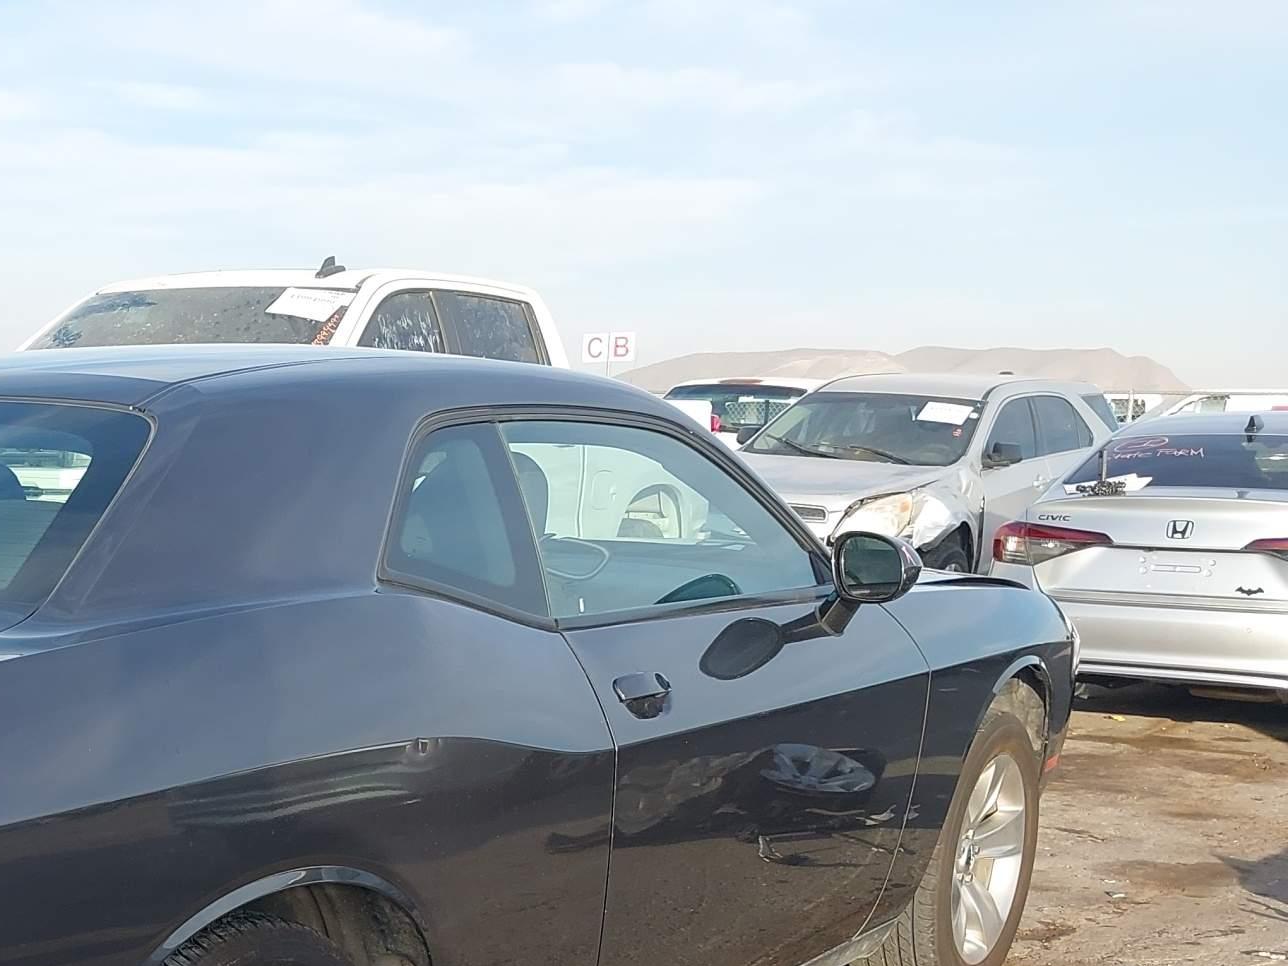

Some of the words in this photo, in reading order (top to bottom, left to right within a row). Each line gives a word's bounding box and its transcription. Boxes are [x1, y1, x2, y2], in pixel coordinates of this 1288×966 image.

[587, 336, 603, 359] C
[613, 336, 629, 357] B
[1038, 514, 1072, 522] CIVIC
